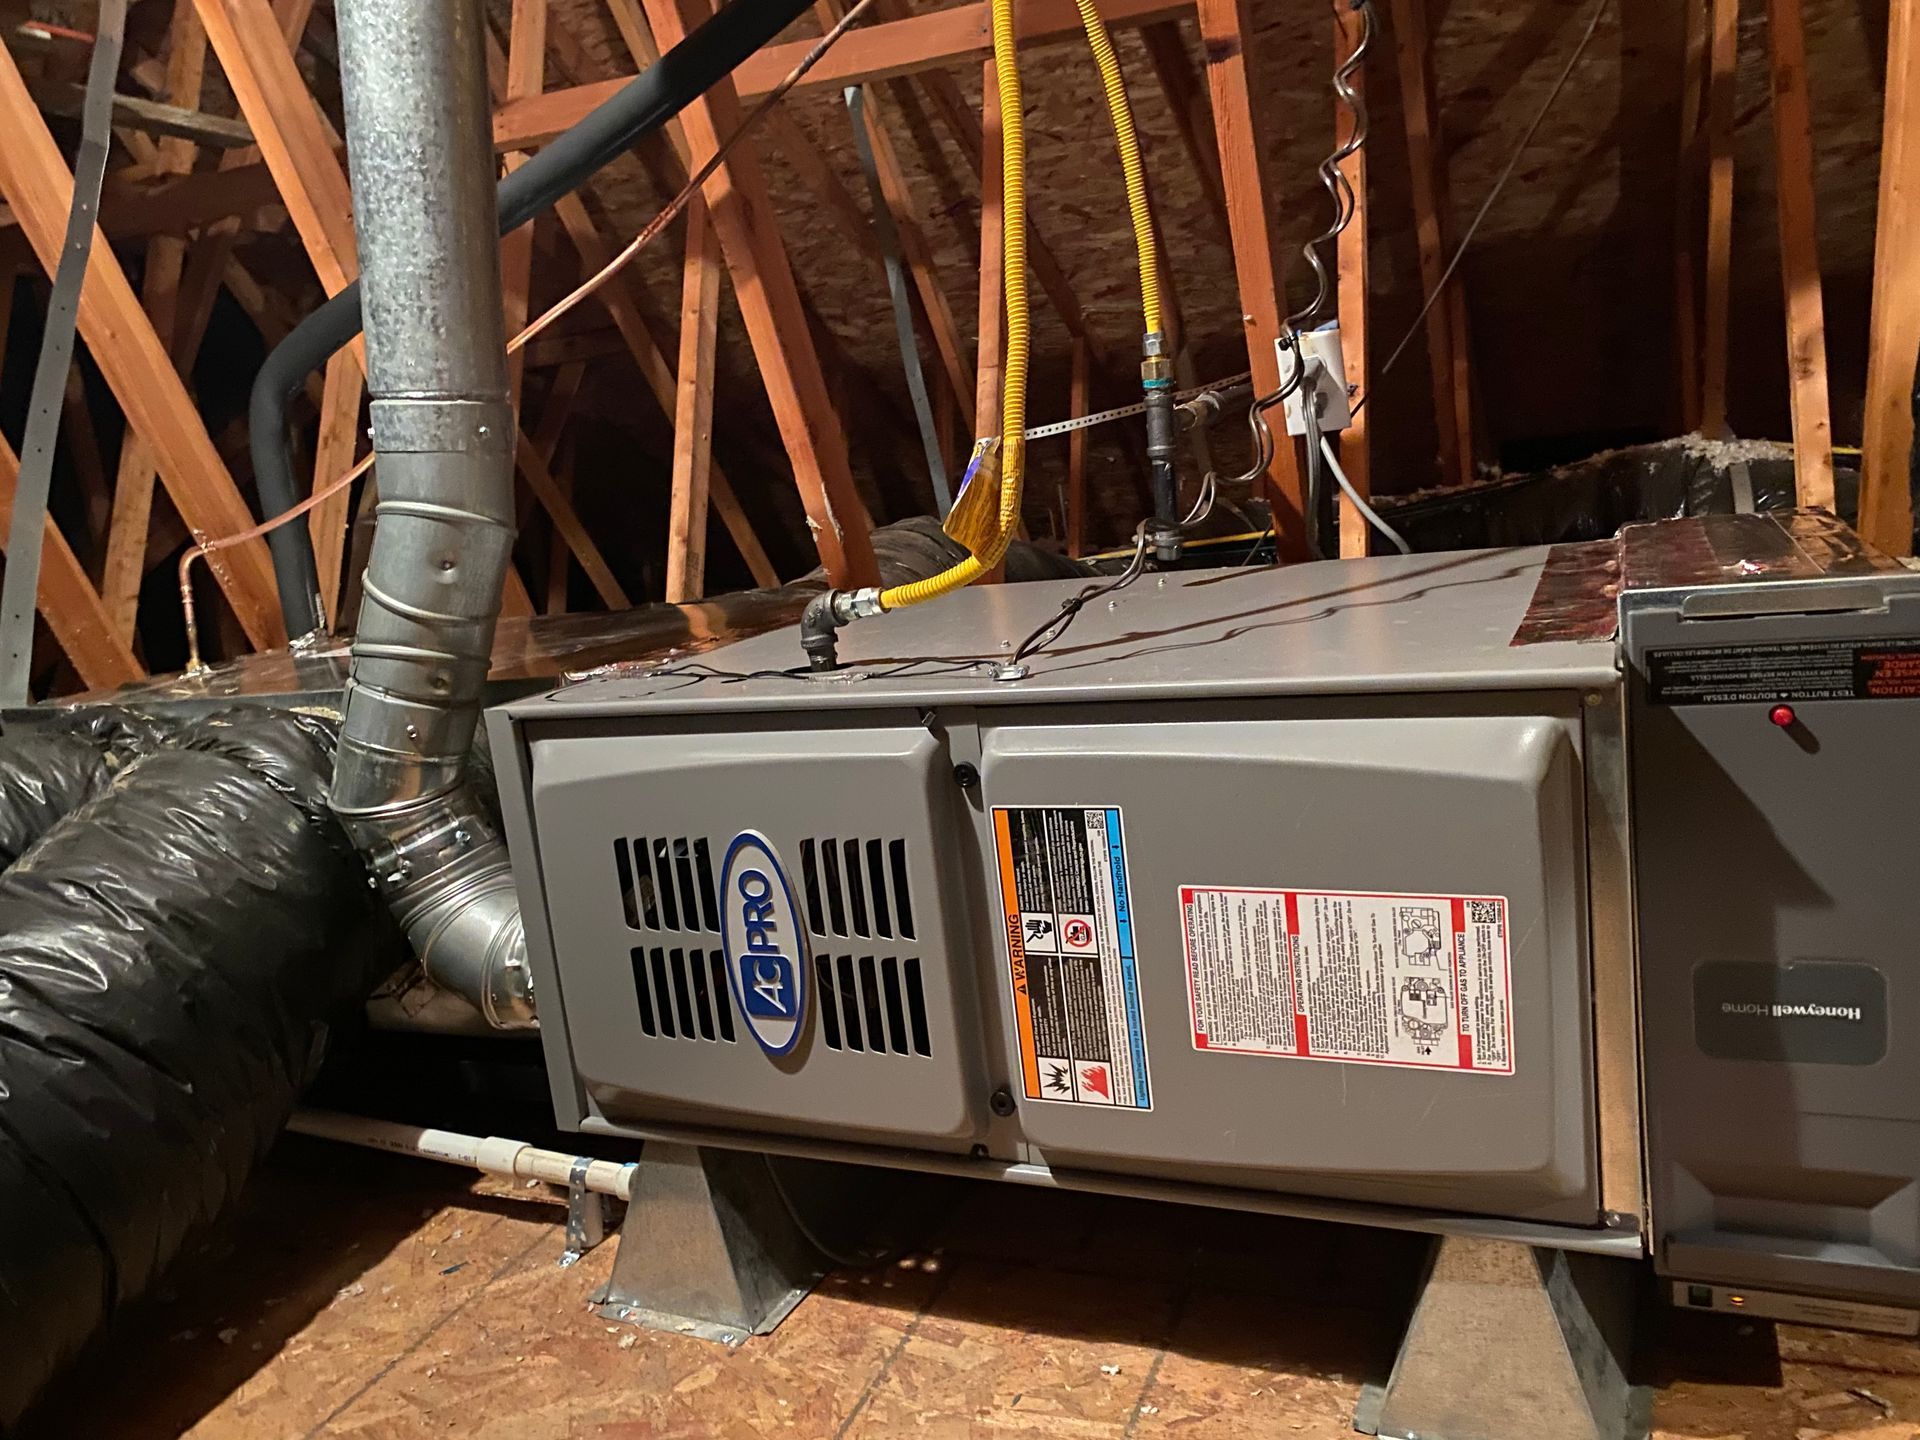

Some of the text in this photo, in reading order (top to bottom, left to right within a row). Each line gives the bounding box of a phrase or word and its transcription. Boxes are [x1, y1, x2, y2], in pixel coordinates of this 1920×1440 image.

[1113, 856, 1125, 911] No Handhold
[1186, 904, 1195, 937] OPERATING
[738, 868, 787, 1013] AC PRO
[1008, 914, 1024, 979] WARNING
[1189, 938, 1197, 960] BEFORE
[1457, 933, 1465, 966] APPLIANCE
[1292, 935, 1304, 1012] OPERATING INSTRUCTIONS
[1459, 968, 1466, 976] TO
[1193, 979, 1201, 1001] SAFETY
[1459, 979, 1467, 991] GAS
[1128, 991, 1136, 1009] behind
[1722, 1002, 1861, 1020] Honeywell Home
[1130, 1010, 1138, 1029] located
[1462, 1023, 1469, 1031] TO
[1134, 1049, 1143, 1079] instructions
[1137, 1080, 1145, 1100] Lighting
